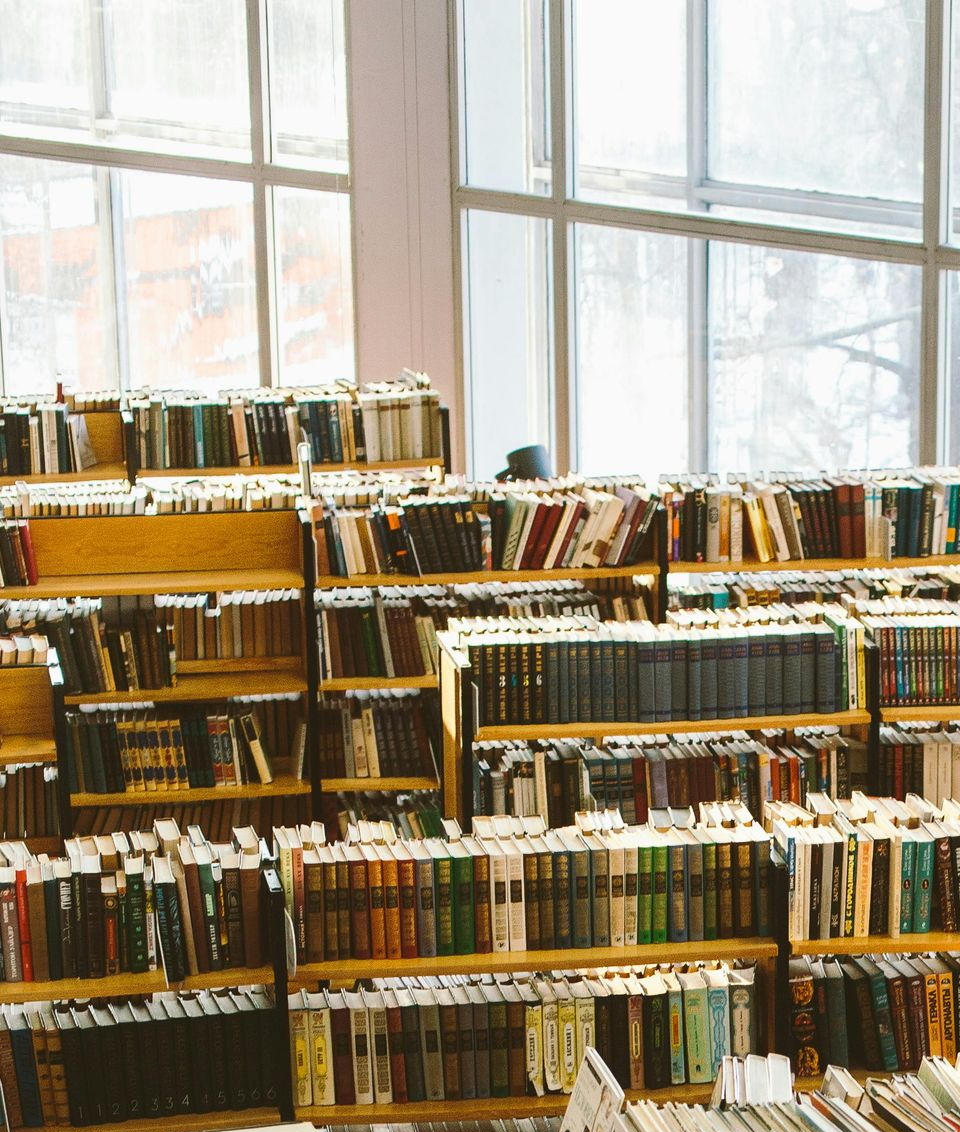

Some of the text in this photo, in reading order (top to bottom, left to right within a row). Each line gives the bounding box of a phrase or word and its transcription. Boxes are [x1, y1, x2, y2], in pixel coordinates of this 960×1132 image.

[926, 989, 939, 1023] ГЕРАКЛ
[940, 988, 954, 1040] АРГОНАВТЫ
[217, 1091, 226, 1104] 5
[250, 1087, 261, 1099] 6
[266, 1087, 276, 1099] 6
[131, 1100, 139, 1112] 2
[151, 1097, 159, 1111] 3
[165, 1096, 174, 1110] 3
[182, 1094, 190, 1107] 4
[111, 1103, 120, 1115] 2
